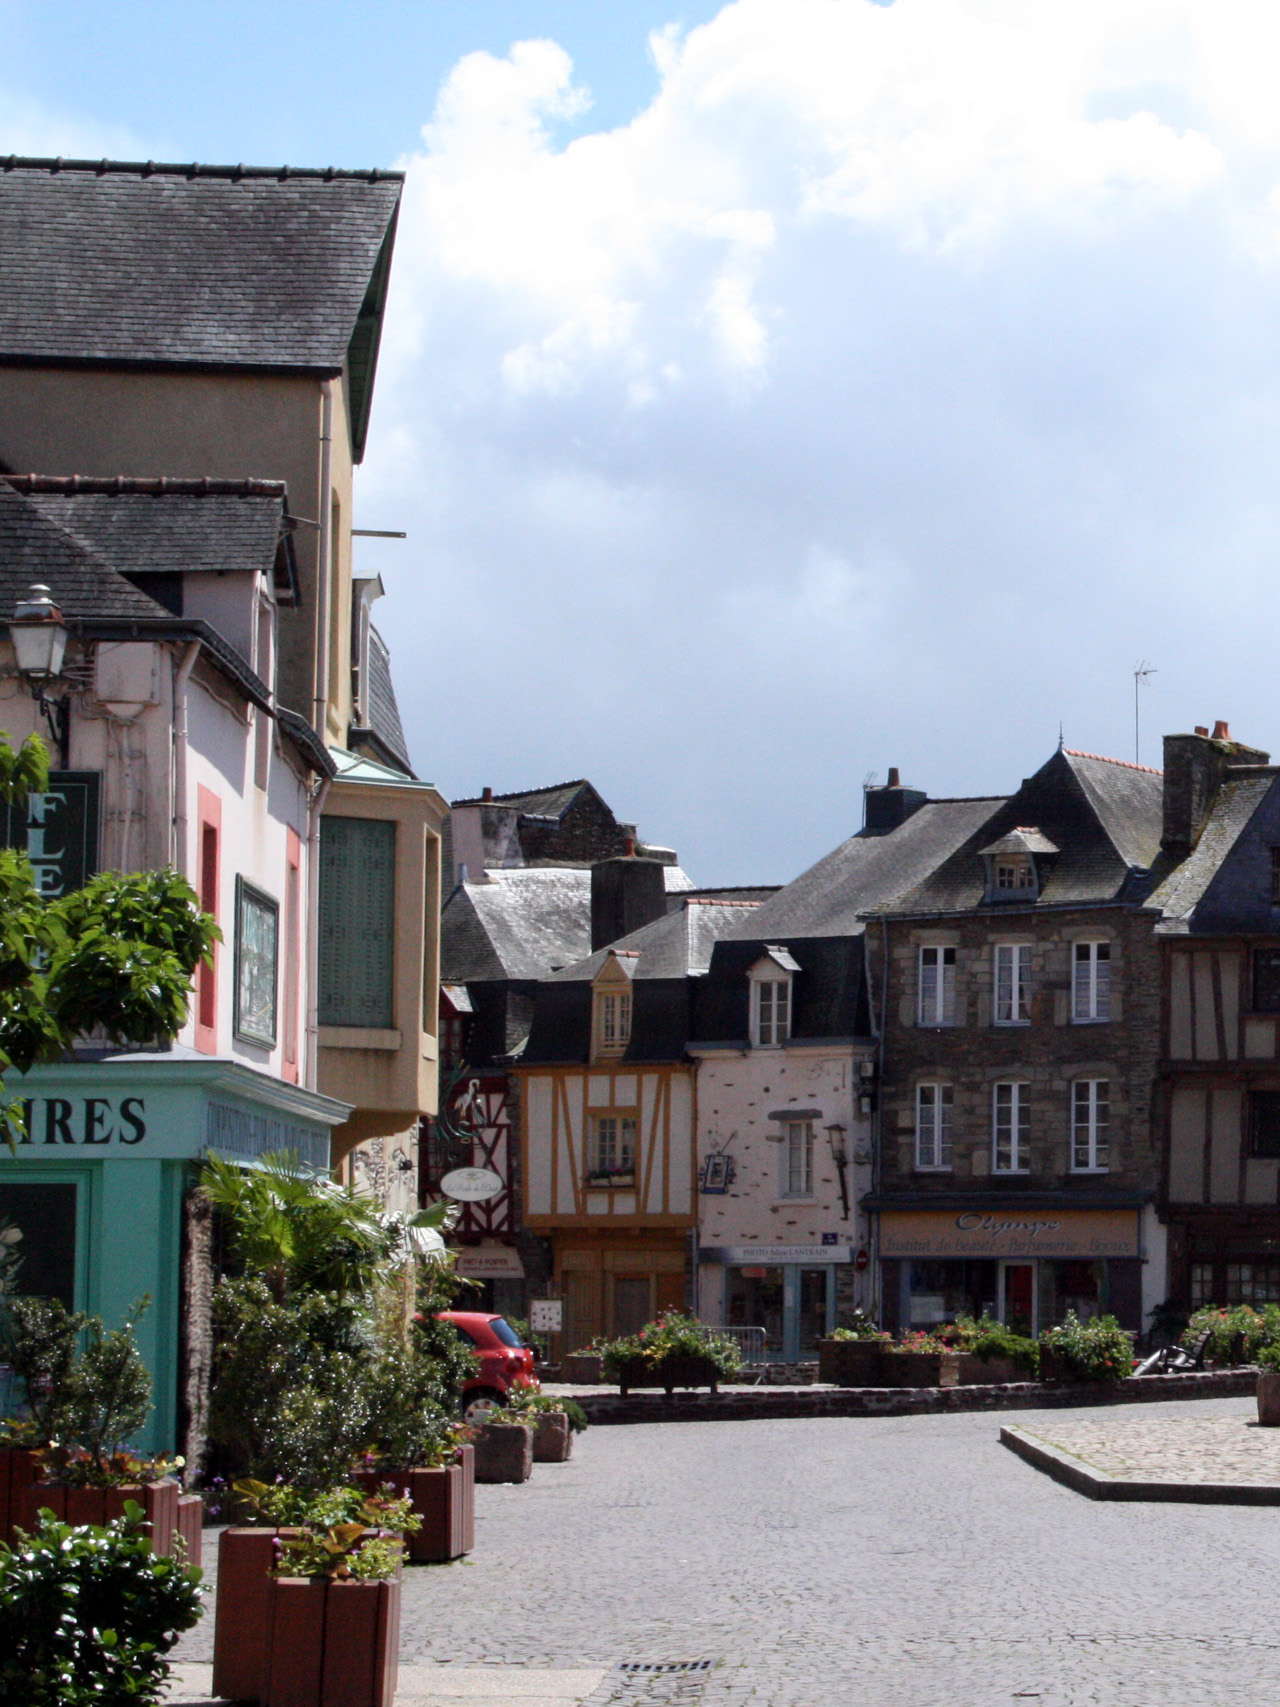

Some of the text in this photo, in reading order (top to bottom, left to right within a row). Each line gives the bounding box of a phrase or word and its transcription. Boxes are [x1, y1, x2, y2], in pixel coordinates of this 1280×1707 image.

[0, 1098, 146, 1145] IRES
[956, 1213, 1061, 1237] Olympe
[743, 1248, 769, 1256] PHOTO
[887, 1238, 931, 1252] Institut
[935, 1238, 951, 1252] de
